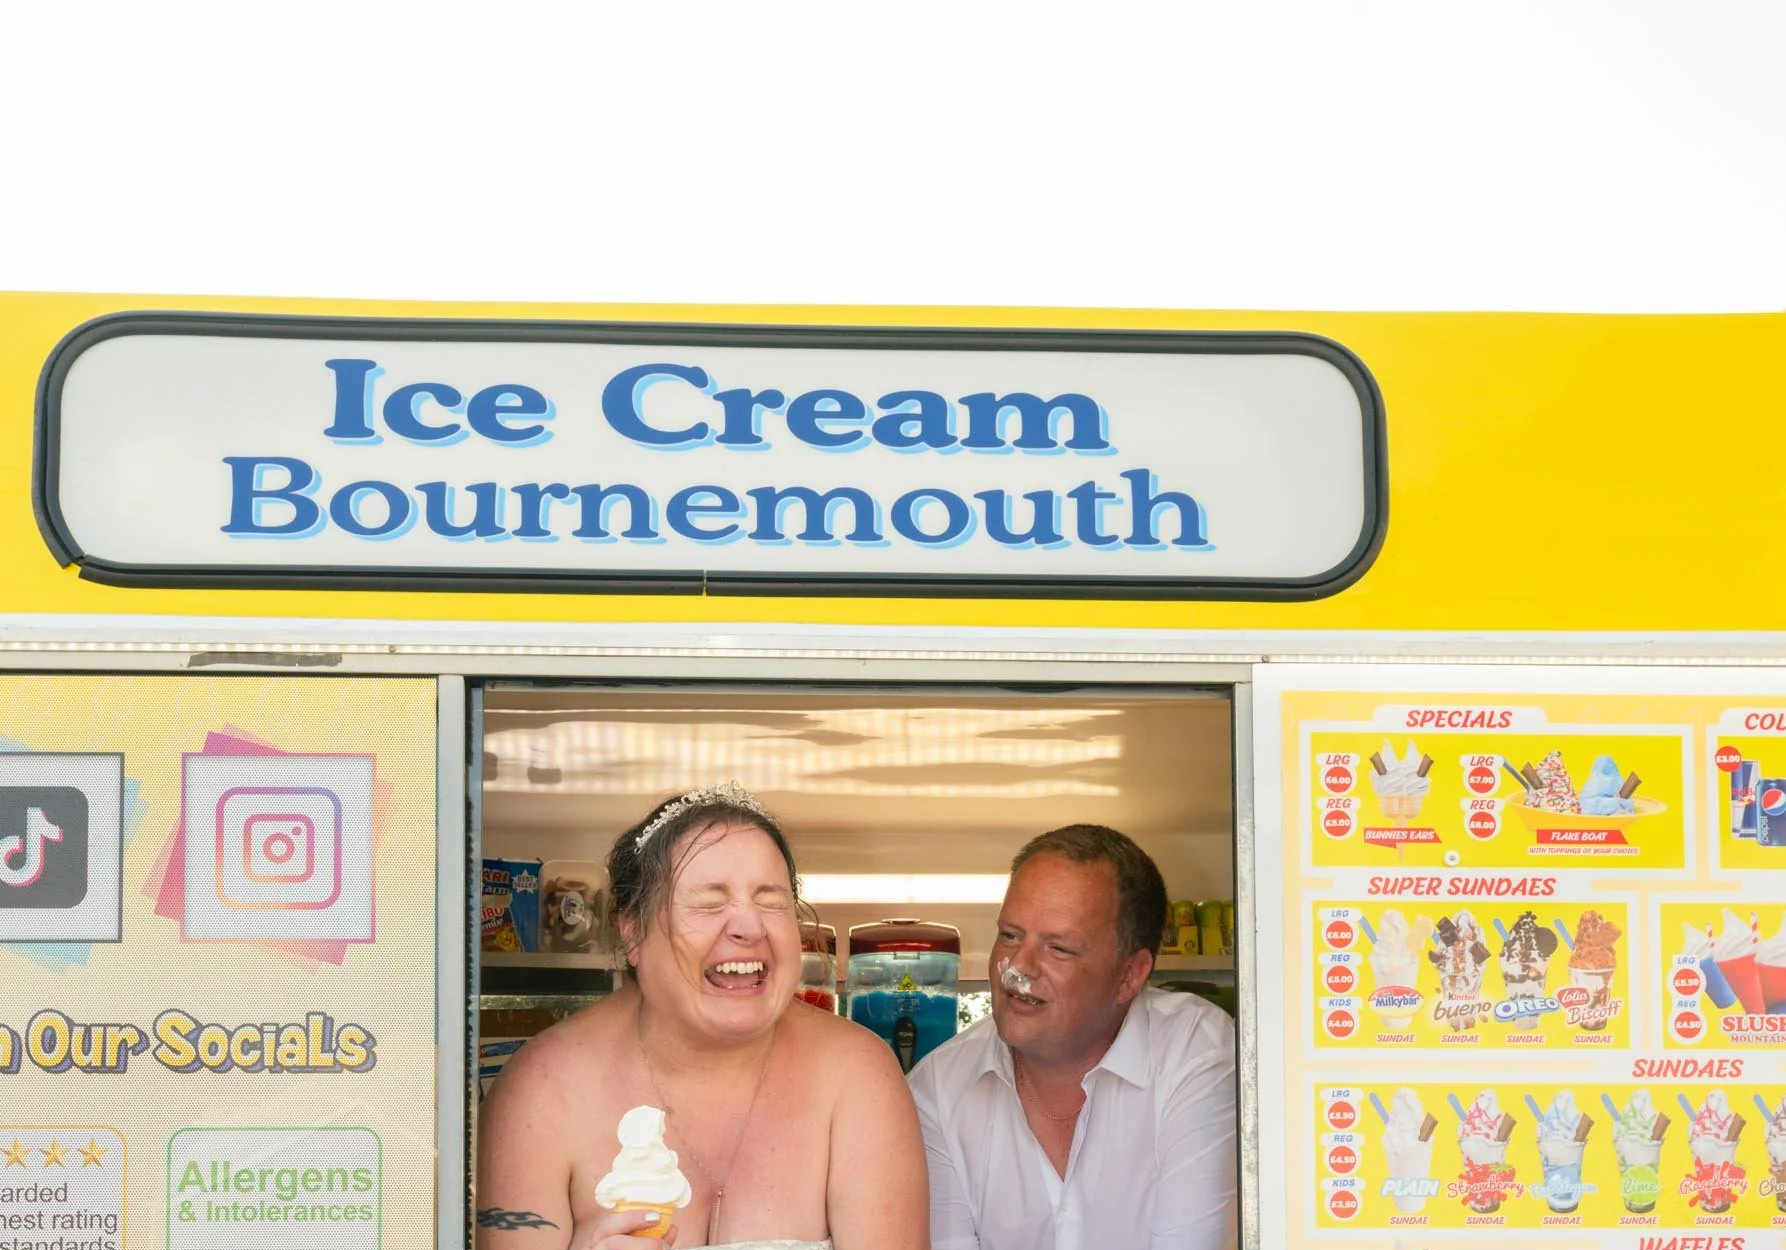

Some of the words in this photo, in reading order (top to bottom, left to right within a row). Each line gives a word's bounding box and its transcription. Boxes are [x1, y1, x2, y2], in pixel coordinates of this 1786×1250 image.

[324, 358, 556, 447] Ice
[602, 363, 1114, 456] Cream
[221, 456, 1218, 554] Bournemouth
[1405, 709, 1512, 729] SPECIALS
[1325, 754, 1350, 766] LRG
[1470, 755, 1494, 767] LRG
[1325, 798, 1351, 810] REG
[1470, 799, 1495, 811] REG
[1364, 829, 1409, 840] BUNNIES
[1410, 829, 1435, 840] EARS
[1551, 831, 1580, 841] FLAKE
[1581, 831, 1608, 841] BOAT
[1528, 847, 1547, 855] WITH
[1367, 876, 1443, 896] SUPER
[1446, 877, 1557, 897] SUNDAES
[1330, 909, 1350, 918] LRG
[1330, 954, 1350, 963] REG
[1676, 956, 1695, 965] LRG
[1375, 994, 1420, 1008] Milkybar
[1562, 990, 1588, 1001] Lotus
[1328, 999, 1351, 1007] KIDS
[1677, 1001, 1696, 1010] REG
[1433, 1000, 1492, 1021] bueno
[1494, 998, 1560, 1022] OREO
[1567, 1000, 1623, 1025] Biscoff
[26, 1008, 150, 1074] Our
[1376, 1034, 1416, 1044] SUNDAE
[1441, 1034, 1480, 1044] SUNDAE
[1506, 1034, 1545, 1044] SUNDAE
[1574, 1034, 1612, 1044] SUNDAE
[1632, 1058, 1744, 1079] SUNDAES
[1331, 1089, 1351, 1098] LRG
[1332, 1134, 1353, 1143] REG
[178, 1160, 374, 1201] Allergens
[1332, 1179, 1356, 1188] KIDS
[1679, 1172, 1748, 1200] Raspberry
[1382, 1179, 1439, 1197] PLAIN
[1446, 1175, 1526, 1198] Strawberry
[0, 1182, 68, 1203] arded
[178, 1200, 197, 1222] &
[206, 1200, 374, 1222] Intolerances
[52, 1209, 118, 1235] rating
[1389, 1216, 1429, 1225] SUNDAE
[1466, 1216, 1505, 1225] SUNDAE
[1543, 1216, 1582, 1225] SUNDAE
[1619, 1216, 1658, 1225] SUNDAE
[1695, 1216, 1734, 1225] SUNDAE
